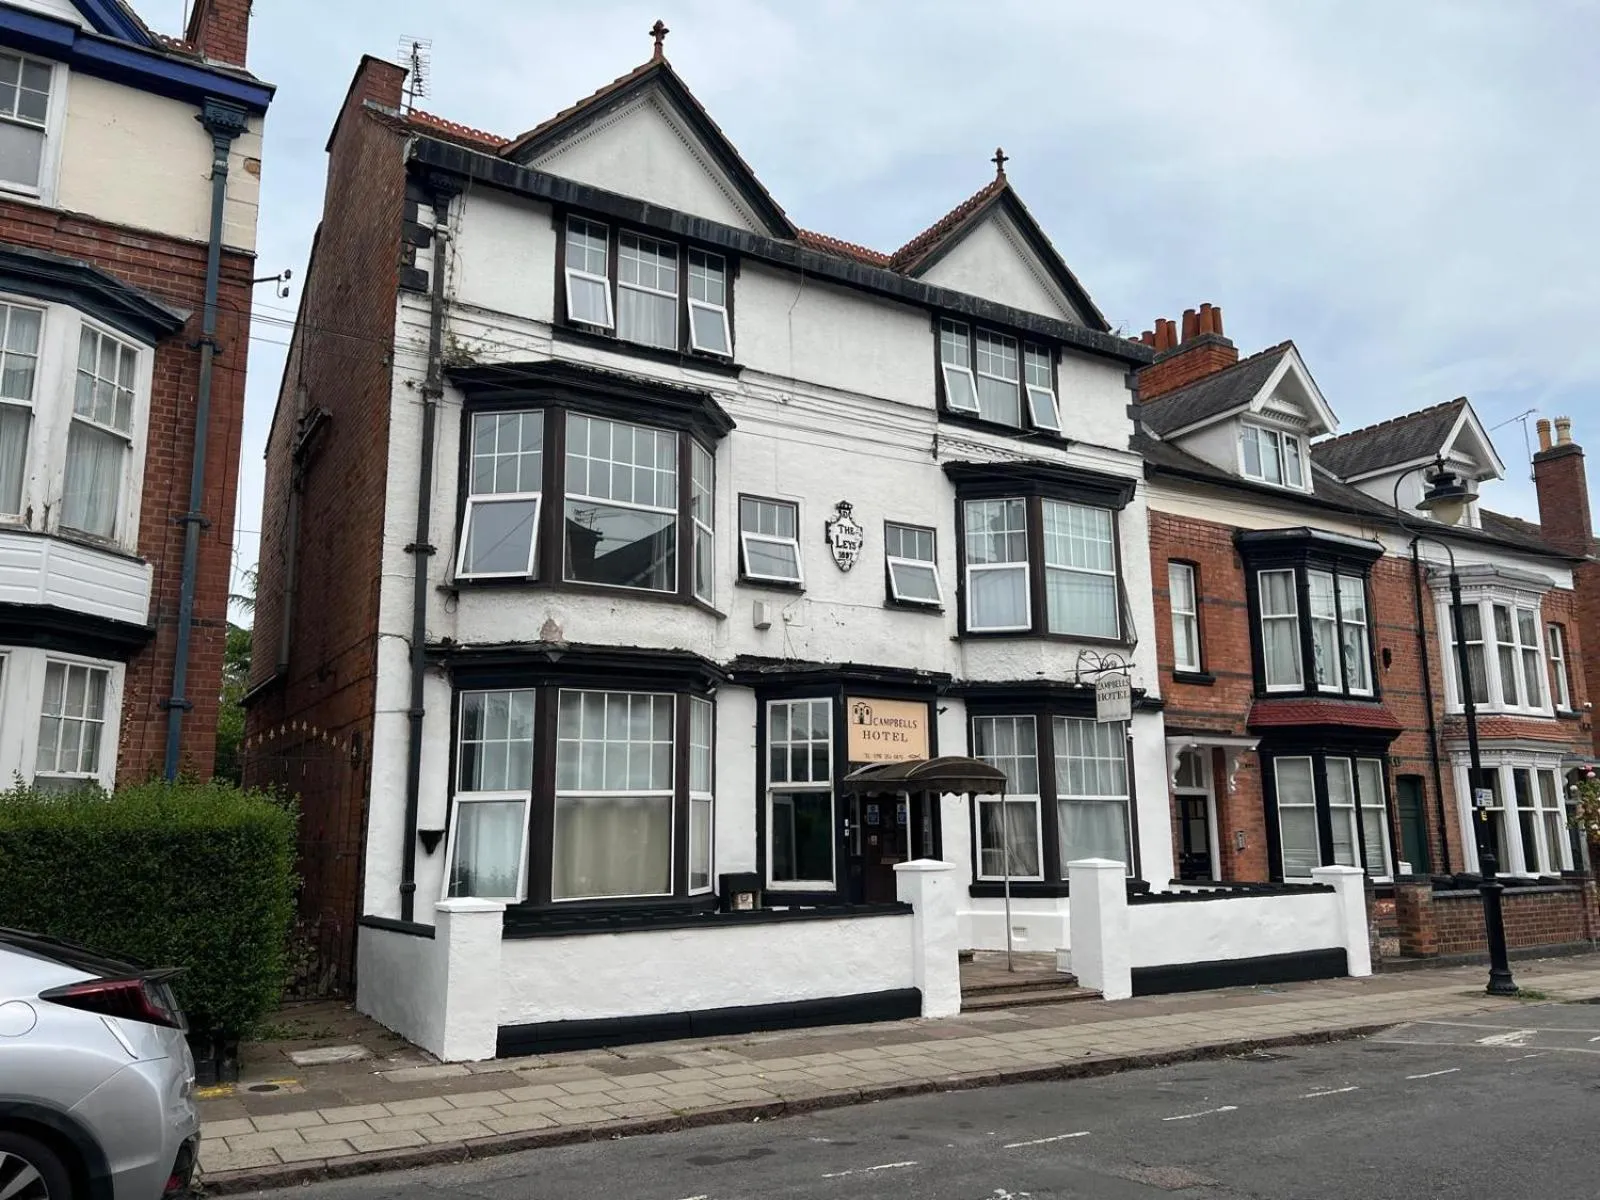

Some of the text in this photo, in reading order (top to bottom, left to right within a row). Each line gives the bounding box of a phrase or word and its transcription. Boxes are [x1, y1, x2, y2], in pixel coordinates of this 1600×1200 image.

[837, 524, 855, 535] THE
[1097, 690, 1131, 702] HOTEL
[873, 717, 918, 729] CAMPBELLS
[862, 730, 908, 742] HOTEL
